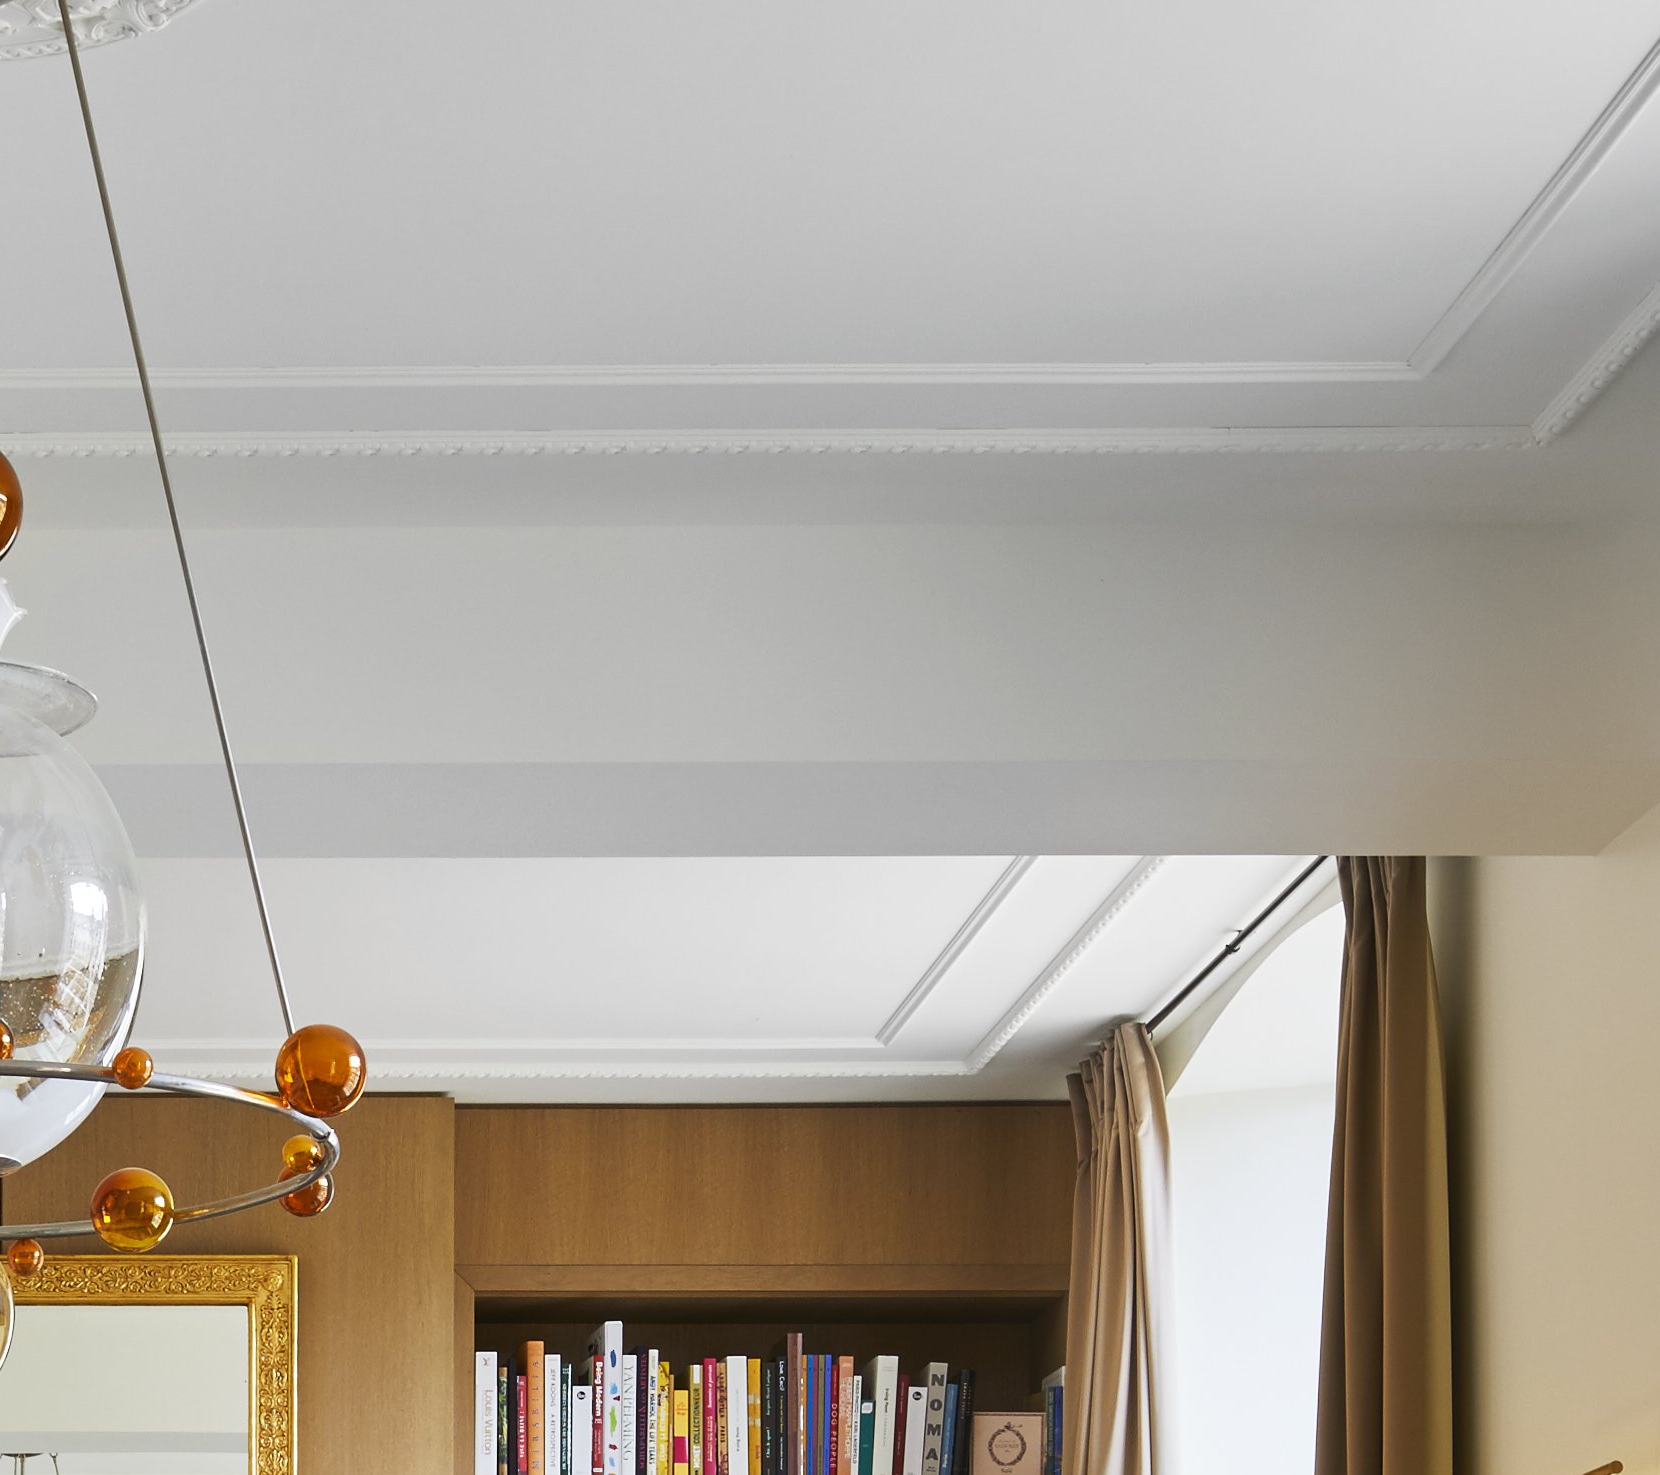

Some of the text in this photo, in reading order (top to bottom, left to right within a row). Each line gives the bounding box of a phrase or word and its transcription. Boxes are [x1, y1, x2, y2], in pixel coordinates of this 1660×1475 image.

[595, 1361, 604, 1416] Being Modern
[623, 1365, 635, 1396] YAN
[639, 1354, 647, 1469] SCHIAPARELLI ARTISTES
[484, 1390, 494, 1455] Louis Vuitton
[830, 1403, 838, 1468] DOG PEOPLE
[925, 1374, 944, 1461] NOMA
